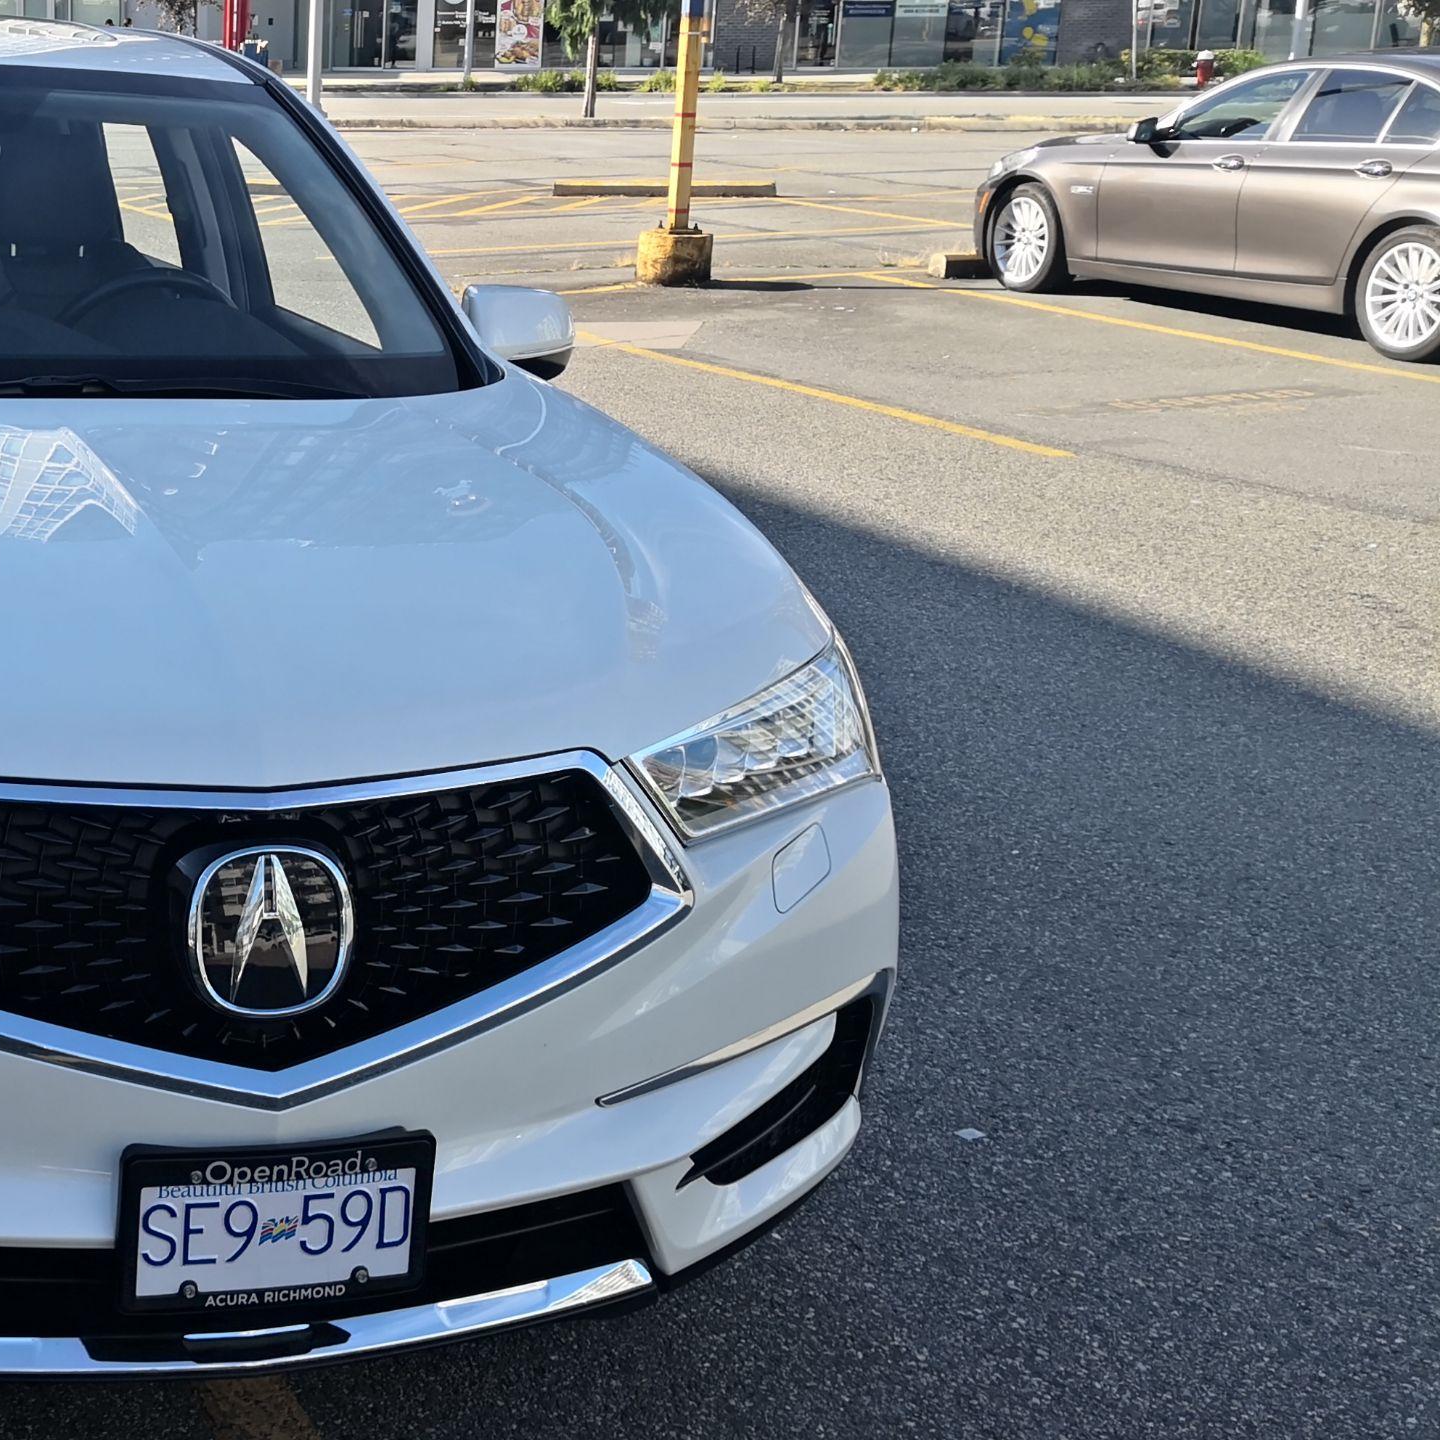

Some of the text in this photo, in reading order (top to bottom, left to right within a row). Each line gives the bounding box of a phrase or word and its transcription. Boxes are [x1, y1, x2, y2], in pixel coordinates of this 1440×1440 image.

[158, 1169, 398, 1198] Beautiful British Columbia
[205, 1150, 362, 1187] OpenRoad
[141, 1185, 411, 1267] SE9 59D
[205, 1284, 346, 1307] ACURA RICHMOND
